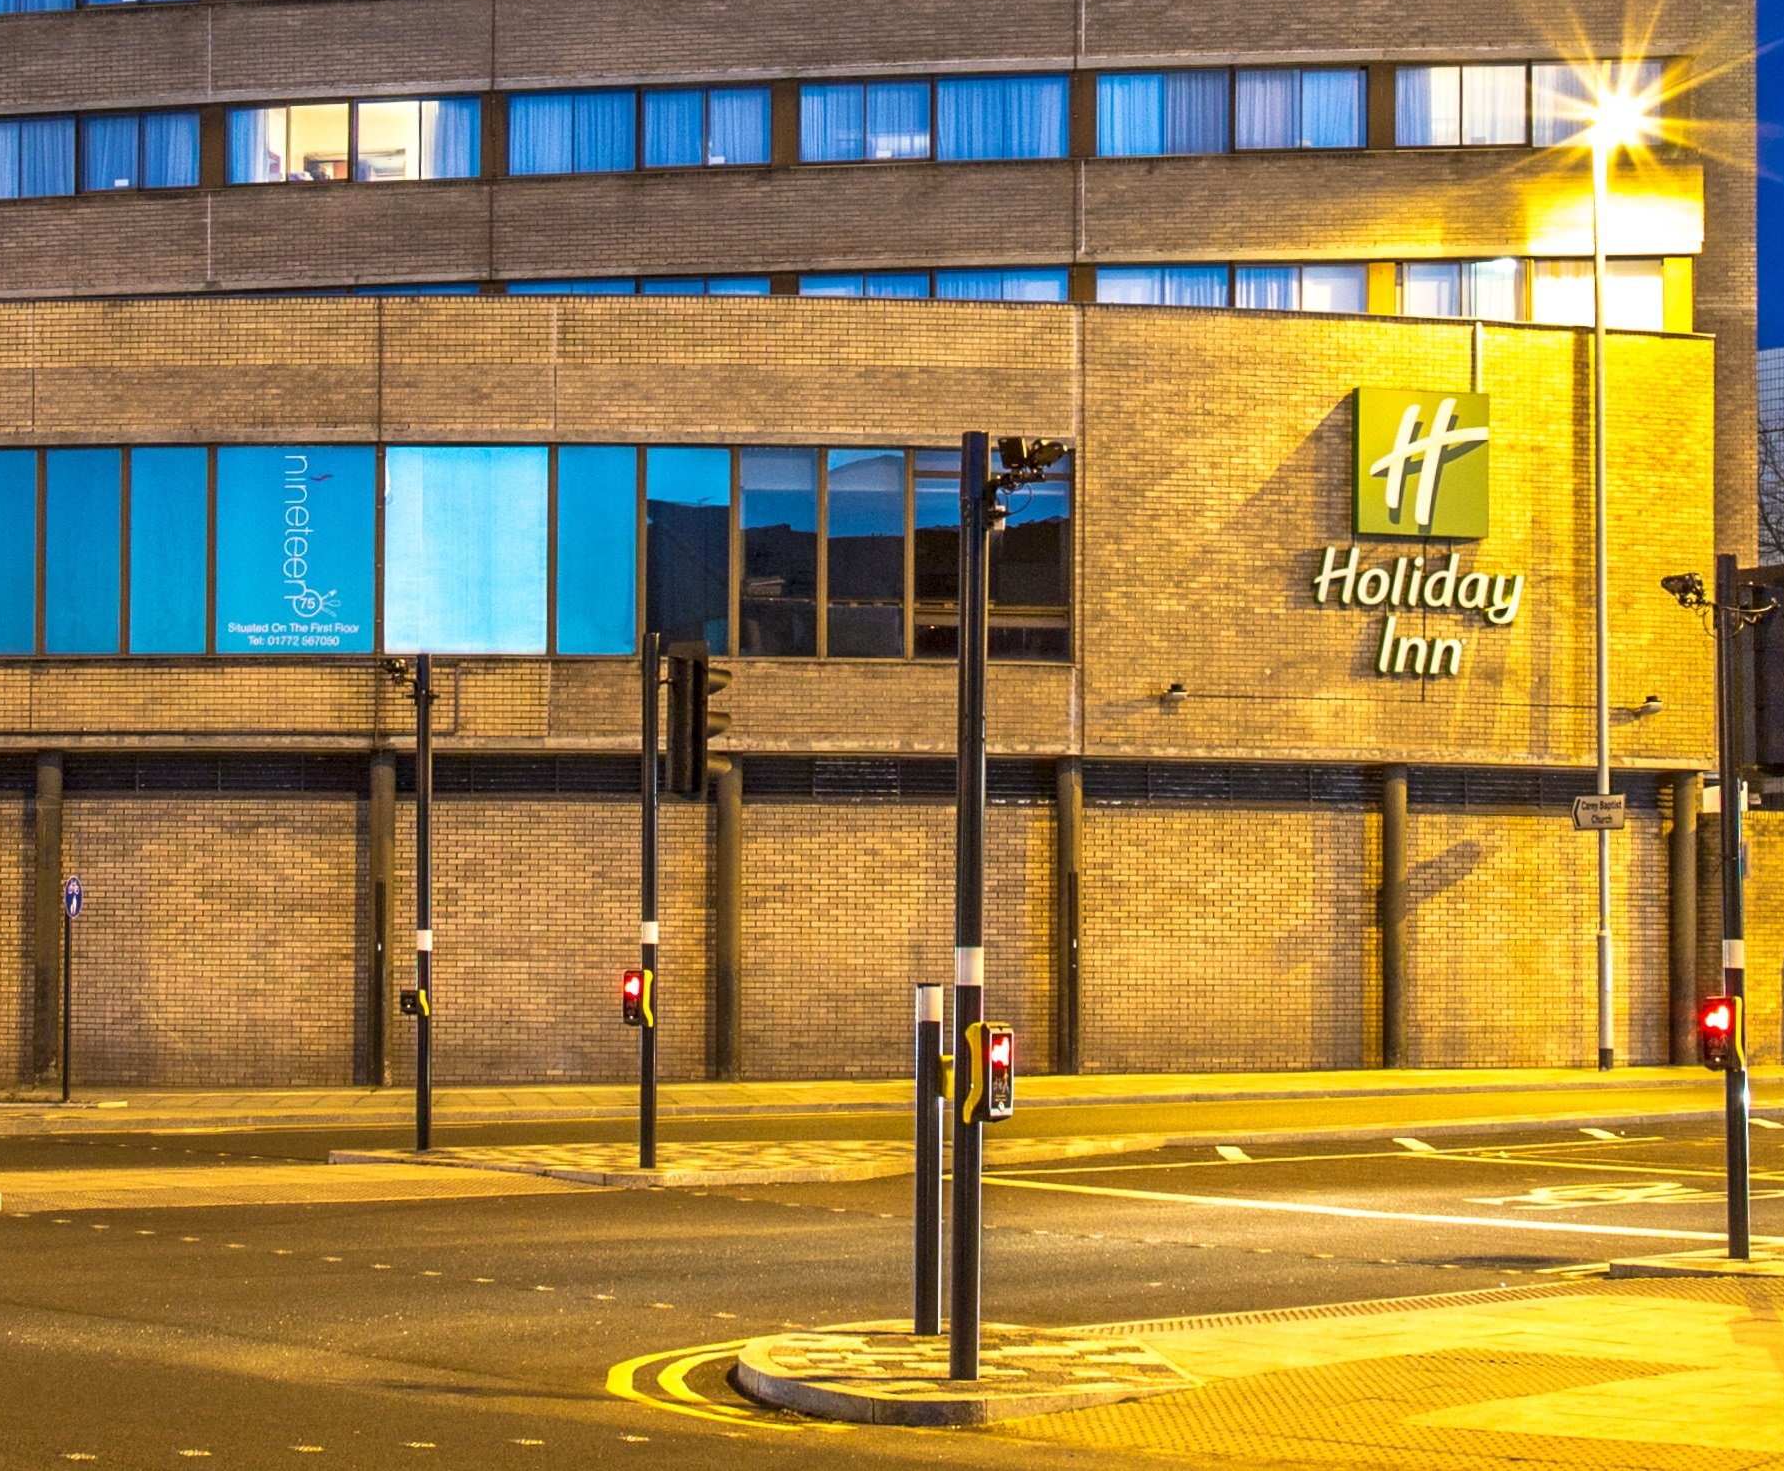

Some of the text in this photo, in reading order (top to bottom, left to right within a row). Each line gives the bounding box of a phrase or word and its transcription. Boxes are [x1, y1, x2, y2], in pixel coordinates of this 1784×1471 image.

[283, 455, 314, 599] nineteen
[1314, 546, 1524, 624] Holiday
[227, 622, 360, 633] Situated On The First Floor
[248, 636, 264, 645] Tel:
[267, 636, 299, 646] 01772
[1378, 615, 1459, 676] Inn
